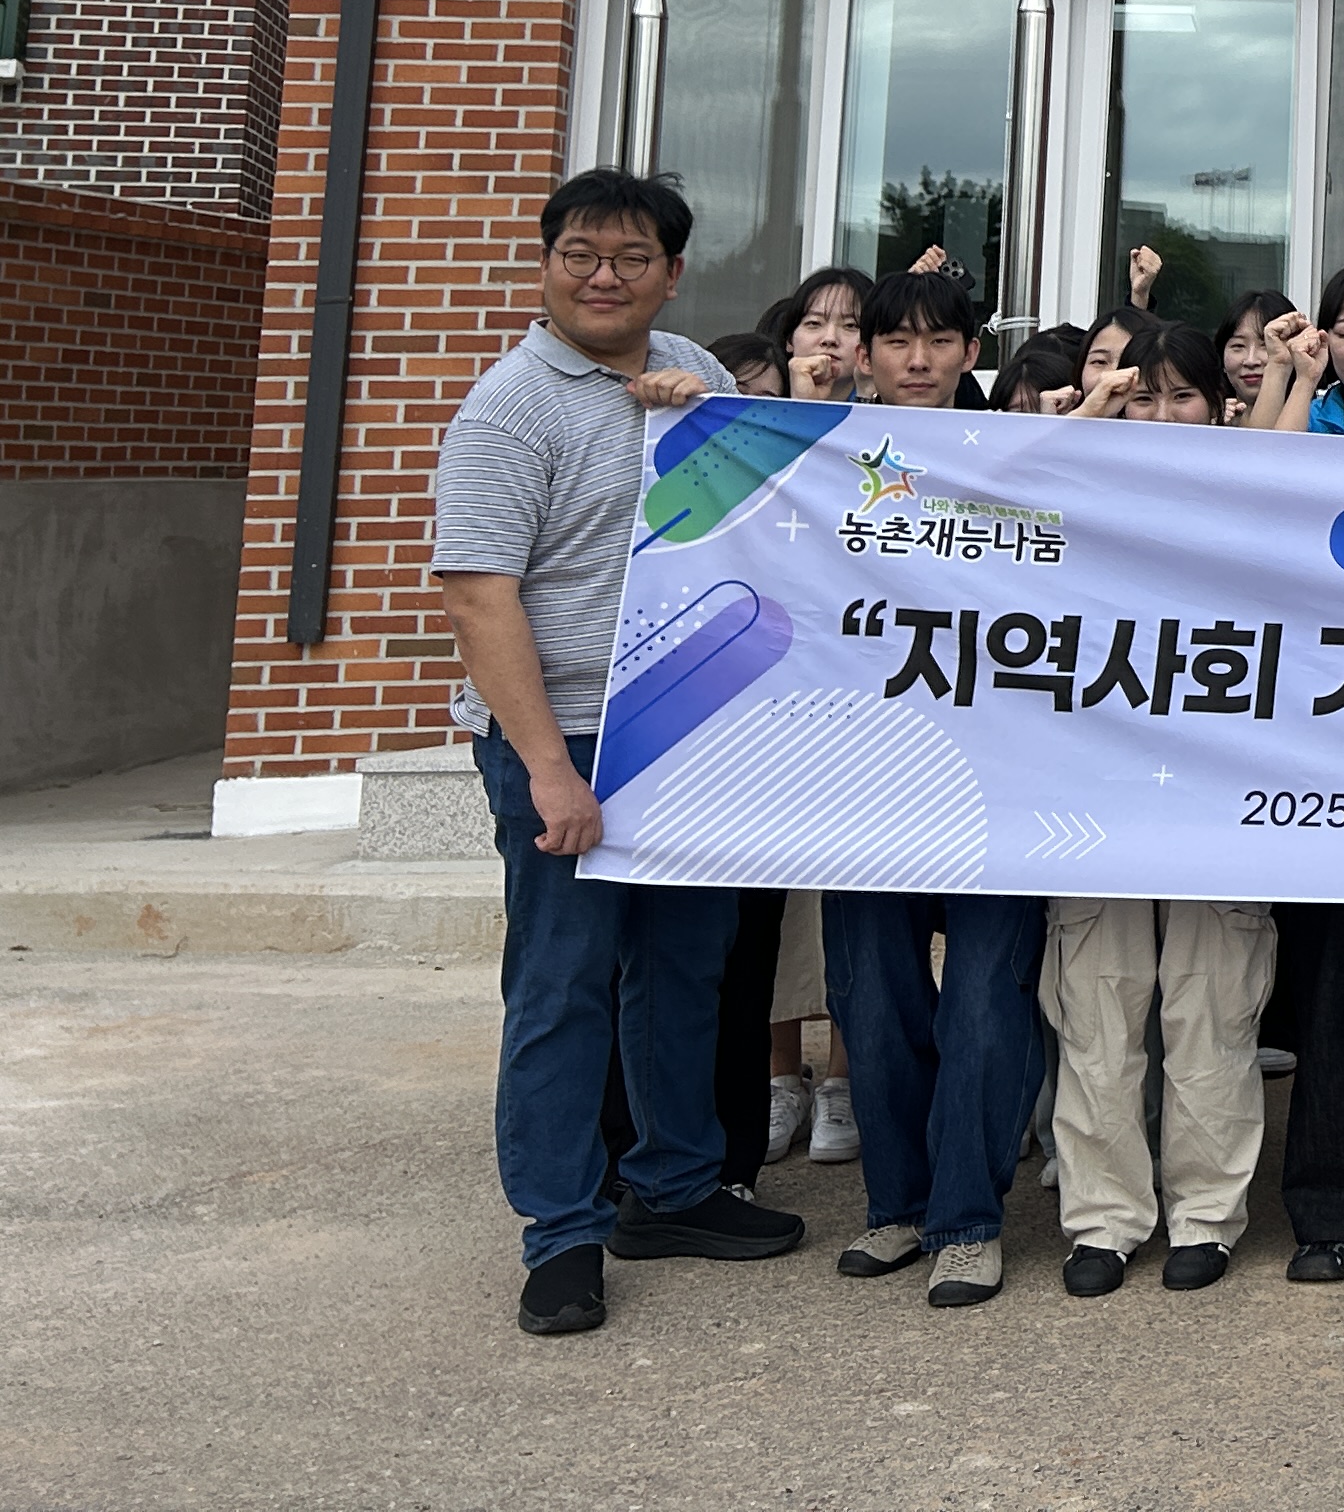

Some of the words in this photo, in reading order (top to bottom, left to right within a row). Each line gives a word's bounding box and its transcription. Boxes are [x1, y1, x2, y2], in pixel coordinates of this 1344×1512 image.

[923, 498, 949, 513] 나와
[954, 501, 992, 516] 농촌의
[839, 513, 1066, 562] 농촌재능나눔
[842, 599, 1282, 719] “지역사회
